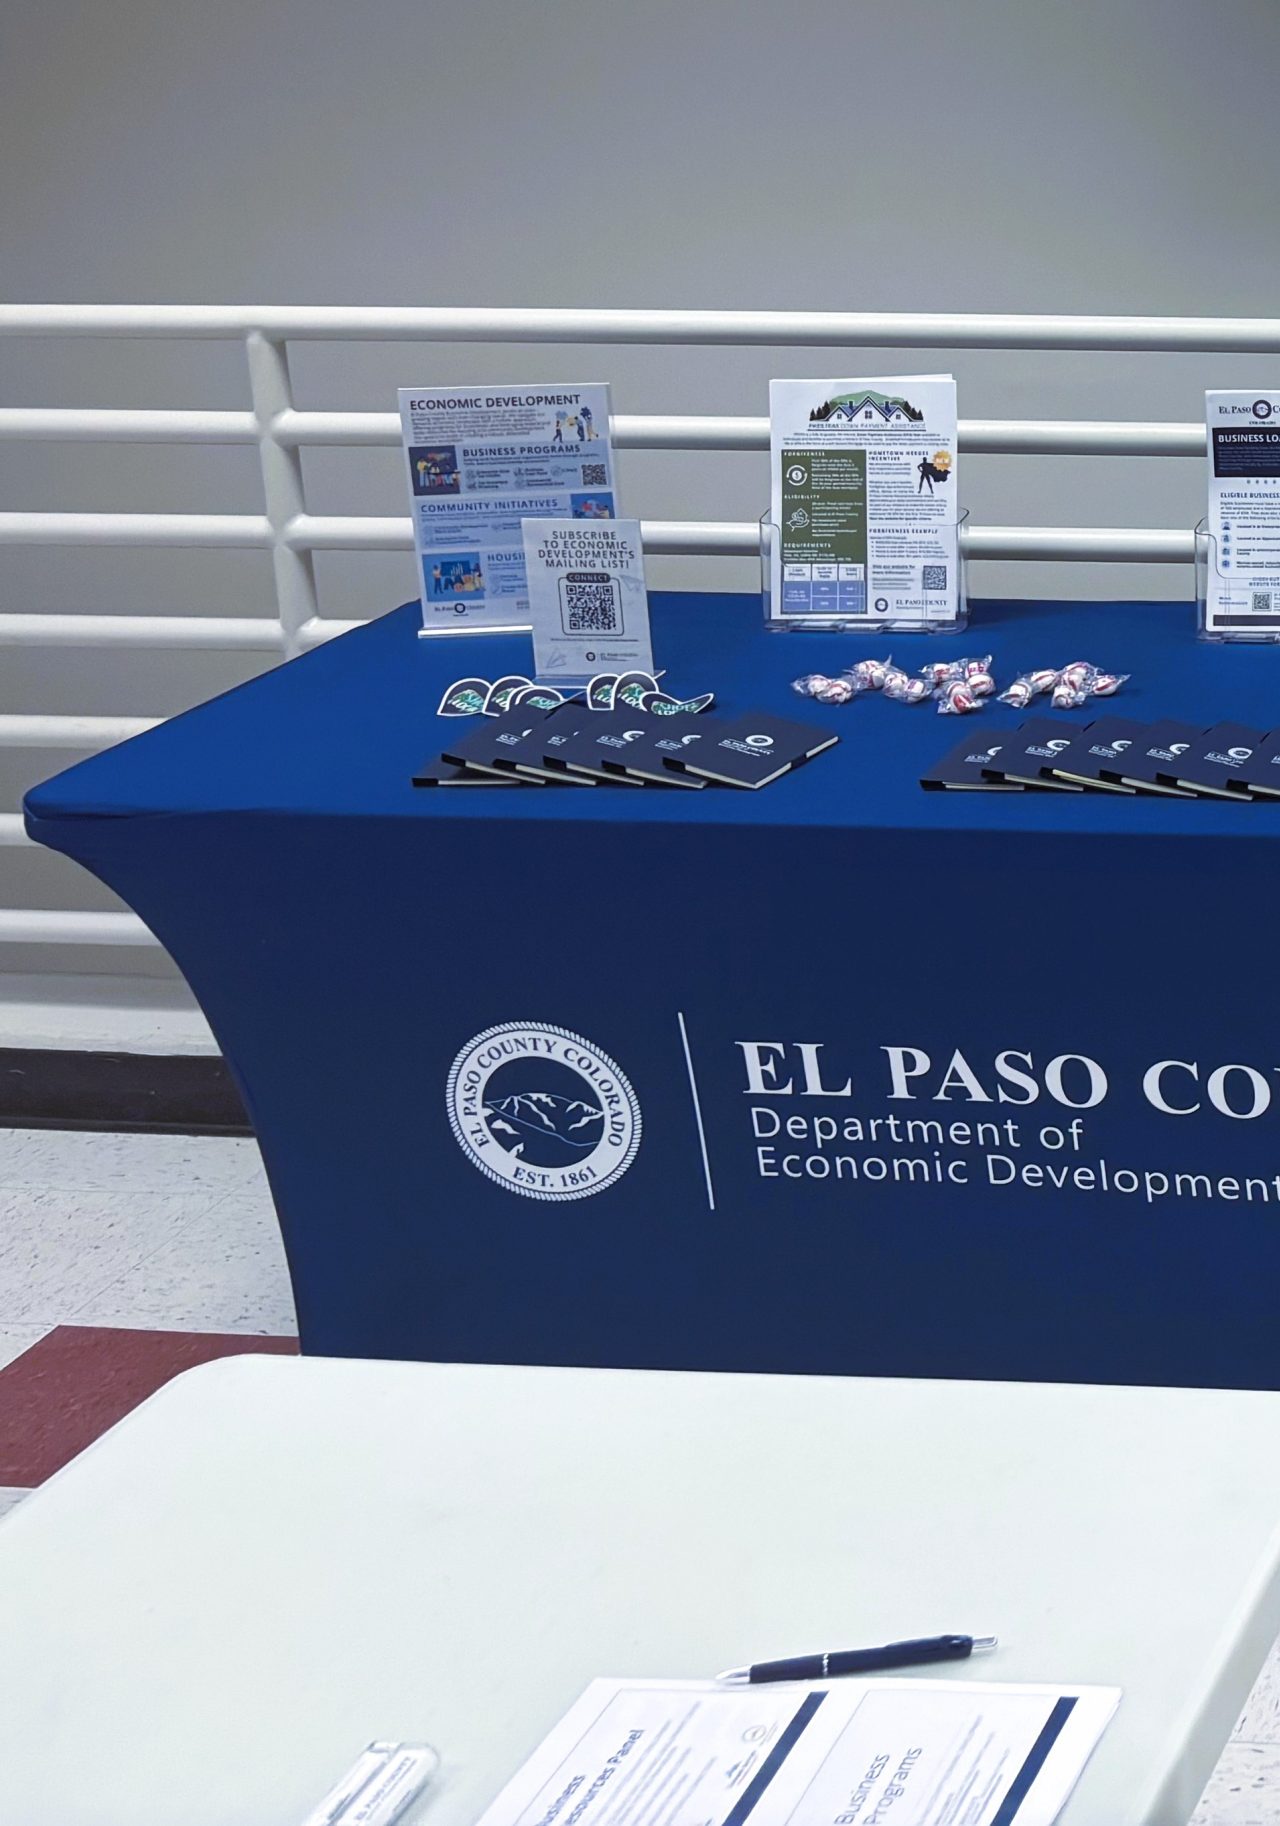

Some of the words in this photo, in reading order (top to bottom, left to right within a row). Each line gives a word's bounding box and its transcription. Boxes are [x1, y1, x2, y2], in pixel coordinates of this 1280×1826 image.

[410, 398, 482, 411] ECONOMIC
[486, 394, 581, 408] DEVELOPMENT
[1218, 405, 1230, 415] EL
[1231, 406, 1252, 415] PASO
[463, 447, 516, 457] BUSINESS
[520, 444, 581, 455] PROGRAMS
[1218, 434, 1264, 443] BUSINESS
[421, 502, 490, 513] COMMUNITY
[494, 499, 558, 510] INITIATIVES
[543, 540, 558, 549] TO
[563, 540, 628, 550] ECONOMIC
[552, 530, 617, 540] SUBSCRIBE
[487, 552, 525, 562] HOUSI
[538, 549, 635, 560] DEVELOPMENT'S
[545, 559, 596, 568] MAILING
[601, 560, 629, 569] LIST!
[477, 1036, 558, 1070] COUNTY
[734, 1040, 853, 1097] EL
[879, 1046, 1109, 1109] PASO
[463, 1069, 482, 1117] PASO
[562, 1046, 626, 1148] COLORADO
[469, 1121, 491, 1148] EL
[750, 1106, 1022, 1148] Department
[1039, 1118, 1084, 1151] of
[512, 1166, 554, 1188] EST.
[559, 1164, 598, 1188] 1861
[757, 1146, 969, 1184] Economic
[606, 1729, 645, 1764] Panel
[833, 1754, 891, 1825] Business
[861, 1747, 923, 1826] Programs
